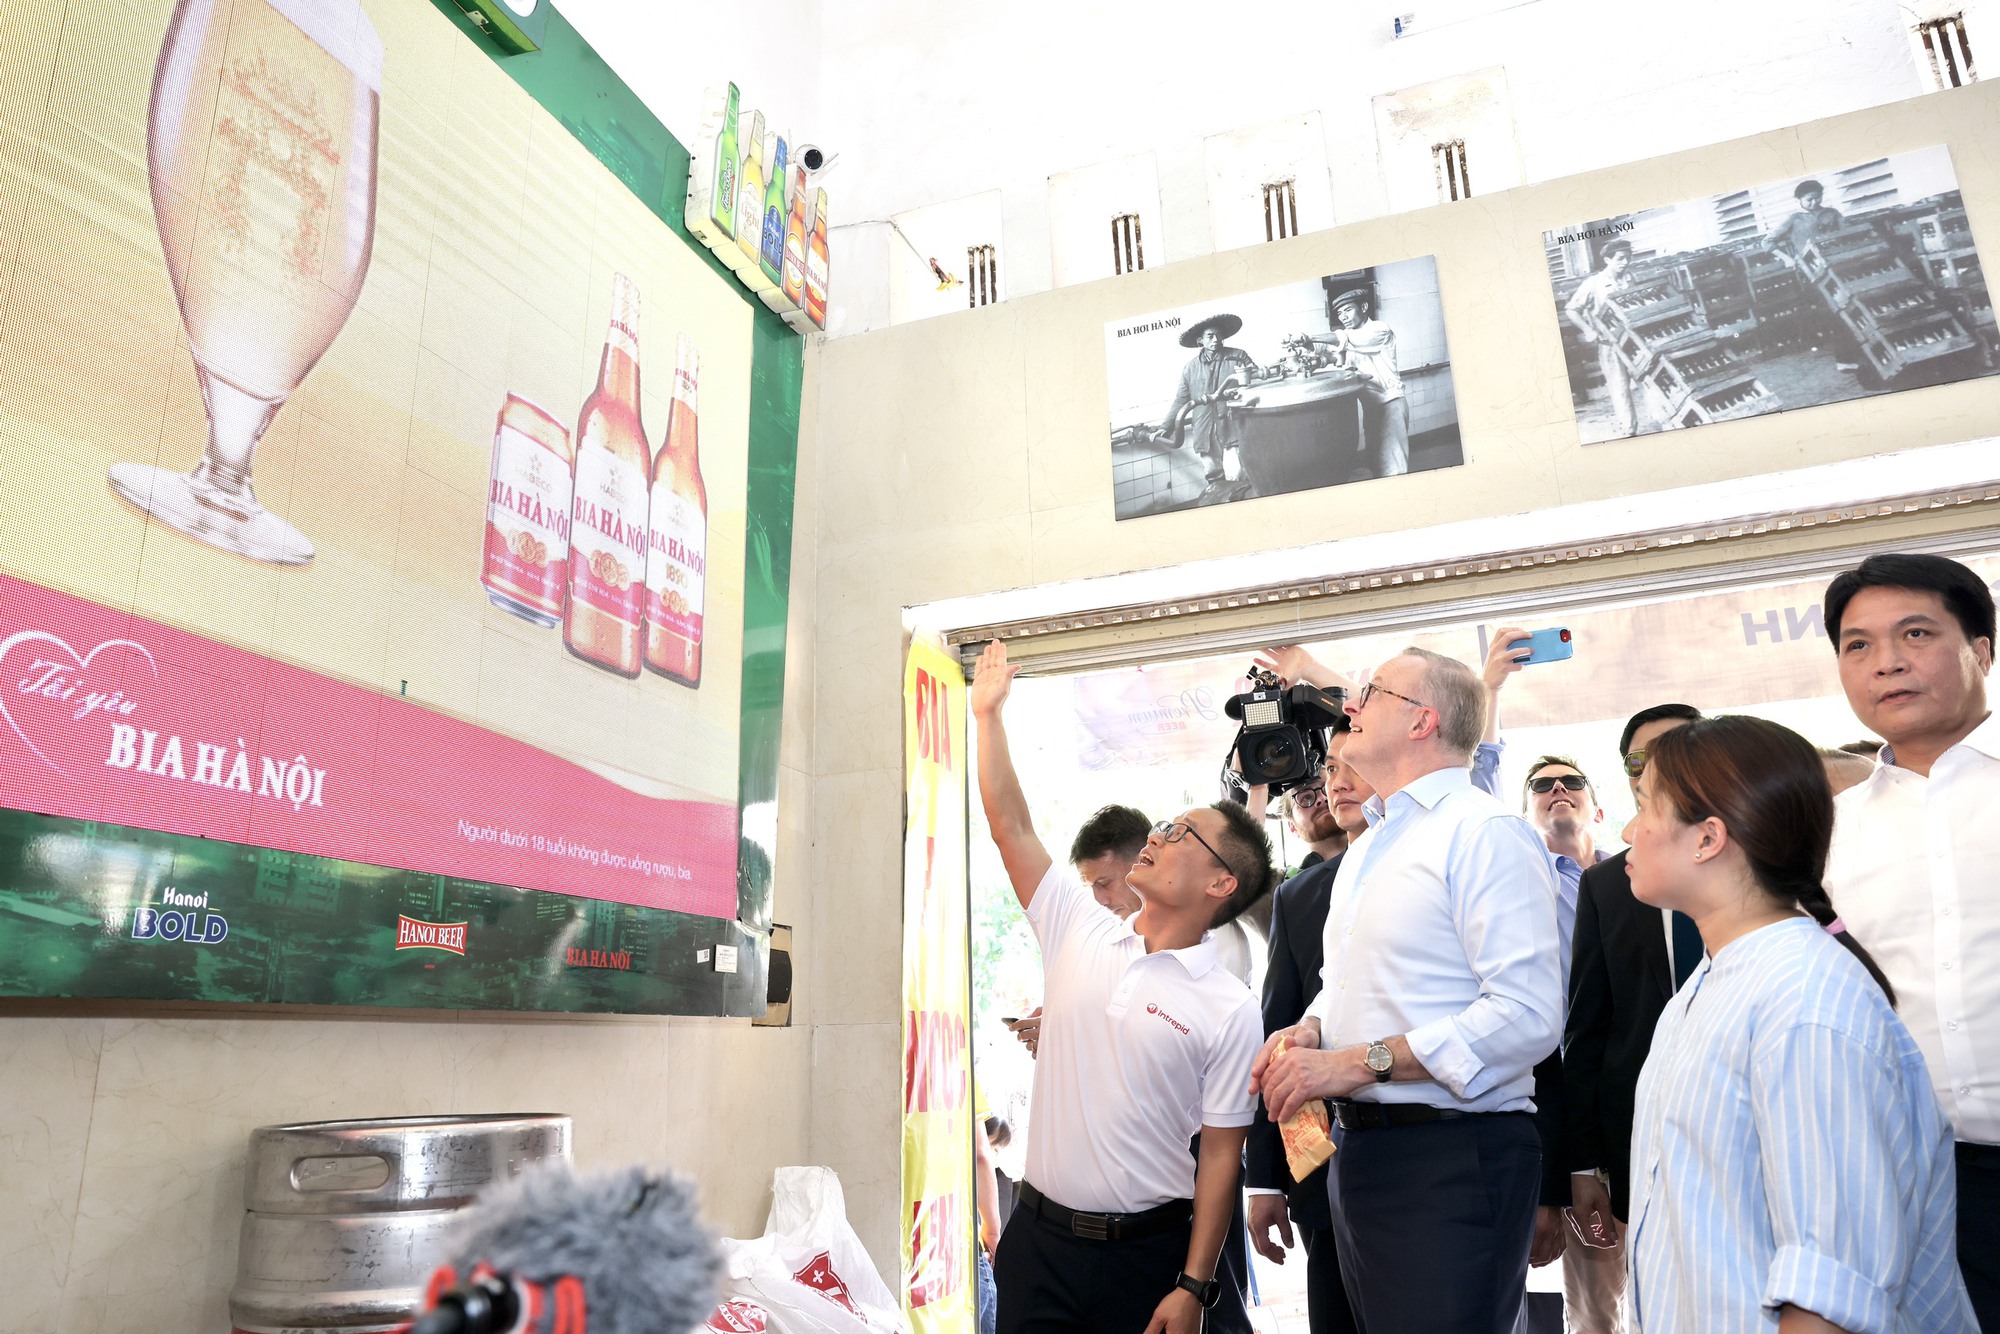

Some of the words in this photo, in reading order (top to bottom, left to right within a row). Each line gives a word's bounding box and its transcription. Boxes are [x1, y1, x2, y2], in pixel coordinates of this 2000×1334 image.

[1557, 234, 1575, 244] BIA
[1577, 230, 1596, 241] HƠI
[1598, 225, 1613, 236] HÀ
[1615, 221, 1634, 233] NỘI
[1117, 328, 1131, 338] BIA
[1133, 324, 1149, 334] HƠI
[1151, 319, 1164, 331] HÀ
[1165, 316, 1181, 328] NỘI
[516, 492, 543, 527] HÀ
[546, 507, 568, 541] NỘI
[575, 495, 597, 530] BIA
[600, 508, 624, 544] HÀ
[626, 523, 647, 559] NỘI
[650, 528, 666, 554] BIA
[668, 537, 686, 566] HÀ
[687, 550, 703, 576] NỘI
[665, 562, 688, 590] 1890
[19, 659, 84, 700] Tôi
[74, 691, 137, 720] yêu
[916, 667, 952, 772] BIA
[105, 722, 186, 780] BIA
[192, 737, 253, 793] HÀ
[258, 753, 327, 811] NỘI
[457, 819, 498, 843] Người
[500, 829, 528, 847] dưới
[532, 835, 545, 851] 18
[546, 836, 566, 855] tuổi
[568, 842, 599, 866] không
[601, 849, 627, 868] được
[628, 853, 651, 876] uống
[163, 886, 208, 909] Hanoi
[132, 907, 228, 944] BOLD
[399, 919, 437, 944] HANOI
[438, 926, 463, 950] BEER
[566, 947, 588, 966] BIA
[589, 945, 608, 968] HÀ
[609, 948, 631, 972] NỘI
